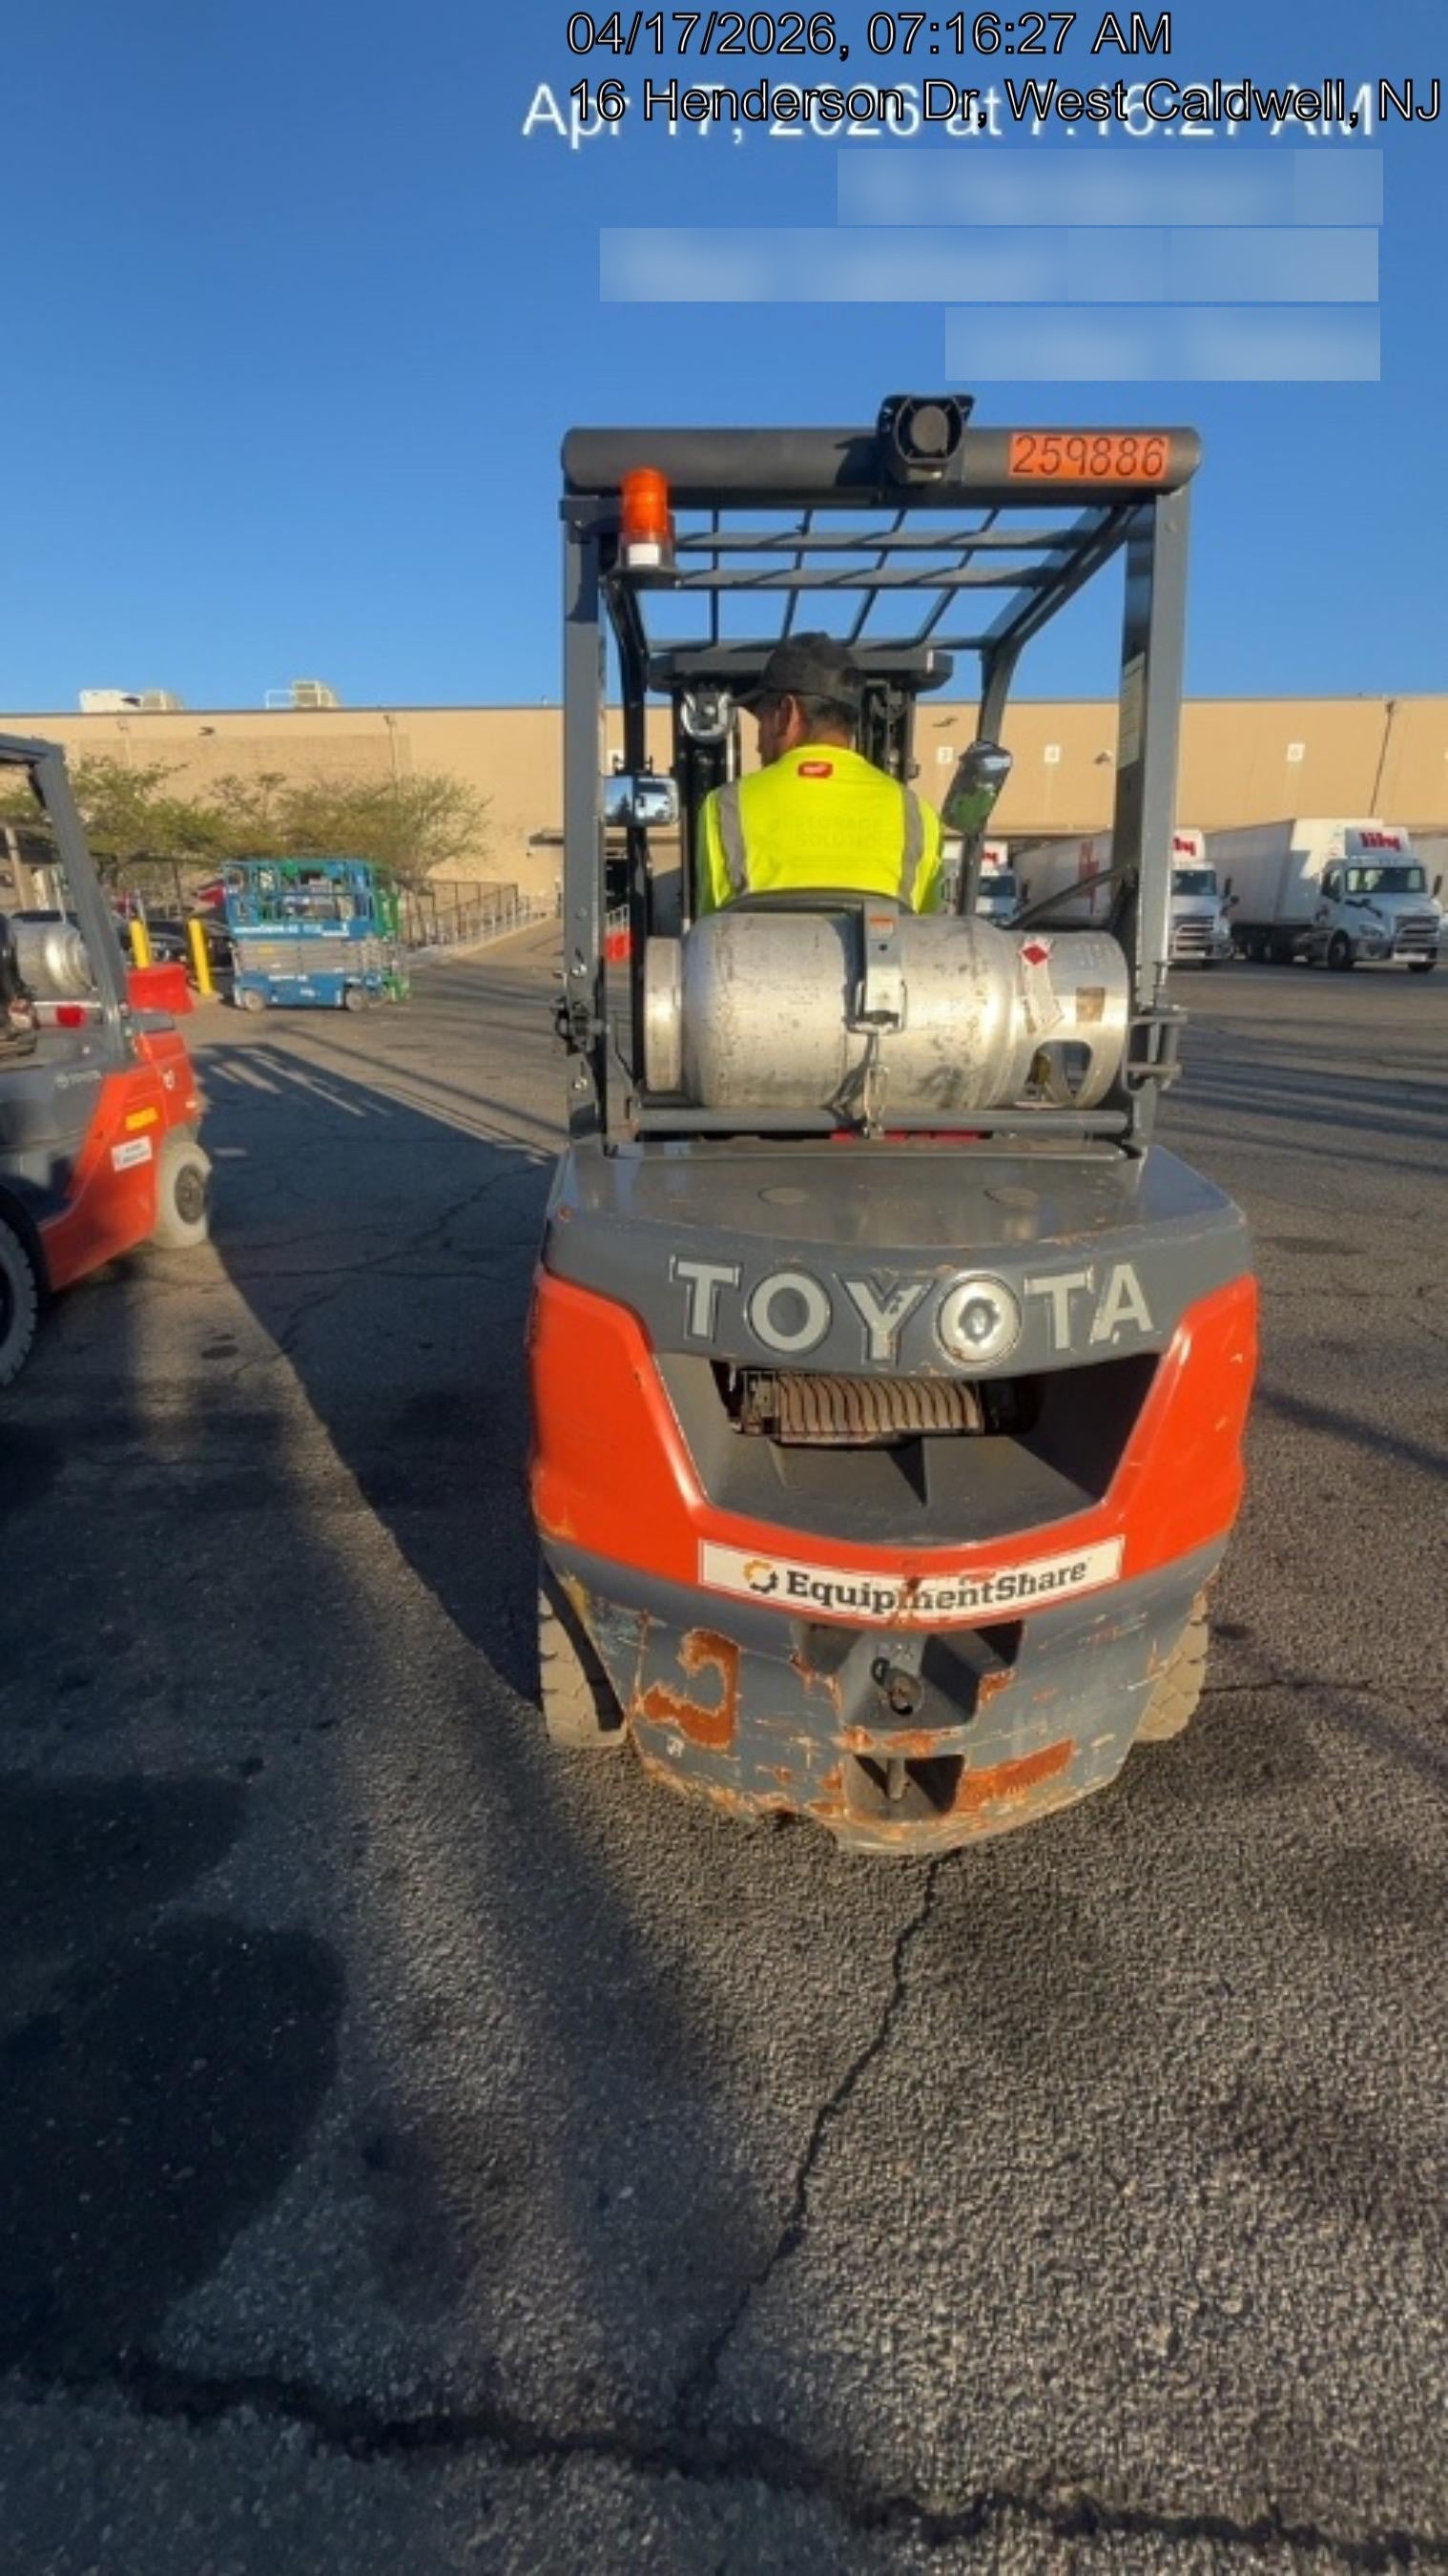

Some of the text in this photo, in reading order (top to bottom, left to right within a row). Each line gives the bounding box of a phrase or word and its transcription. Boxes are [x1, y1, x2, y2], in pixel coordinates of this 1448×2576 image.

[1012, 434, 1166, 476] 259886
[671, 1257, 1157, 1367] TOYOTA
[784, 1560, 1087, 1613] EquipmentShare
